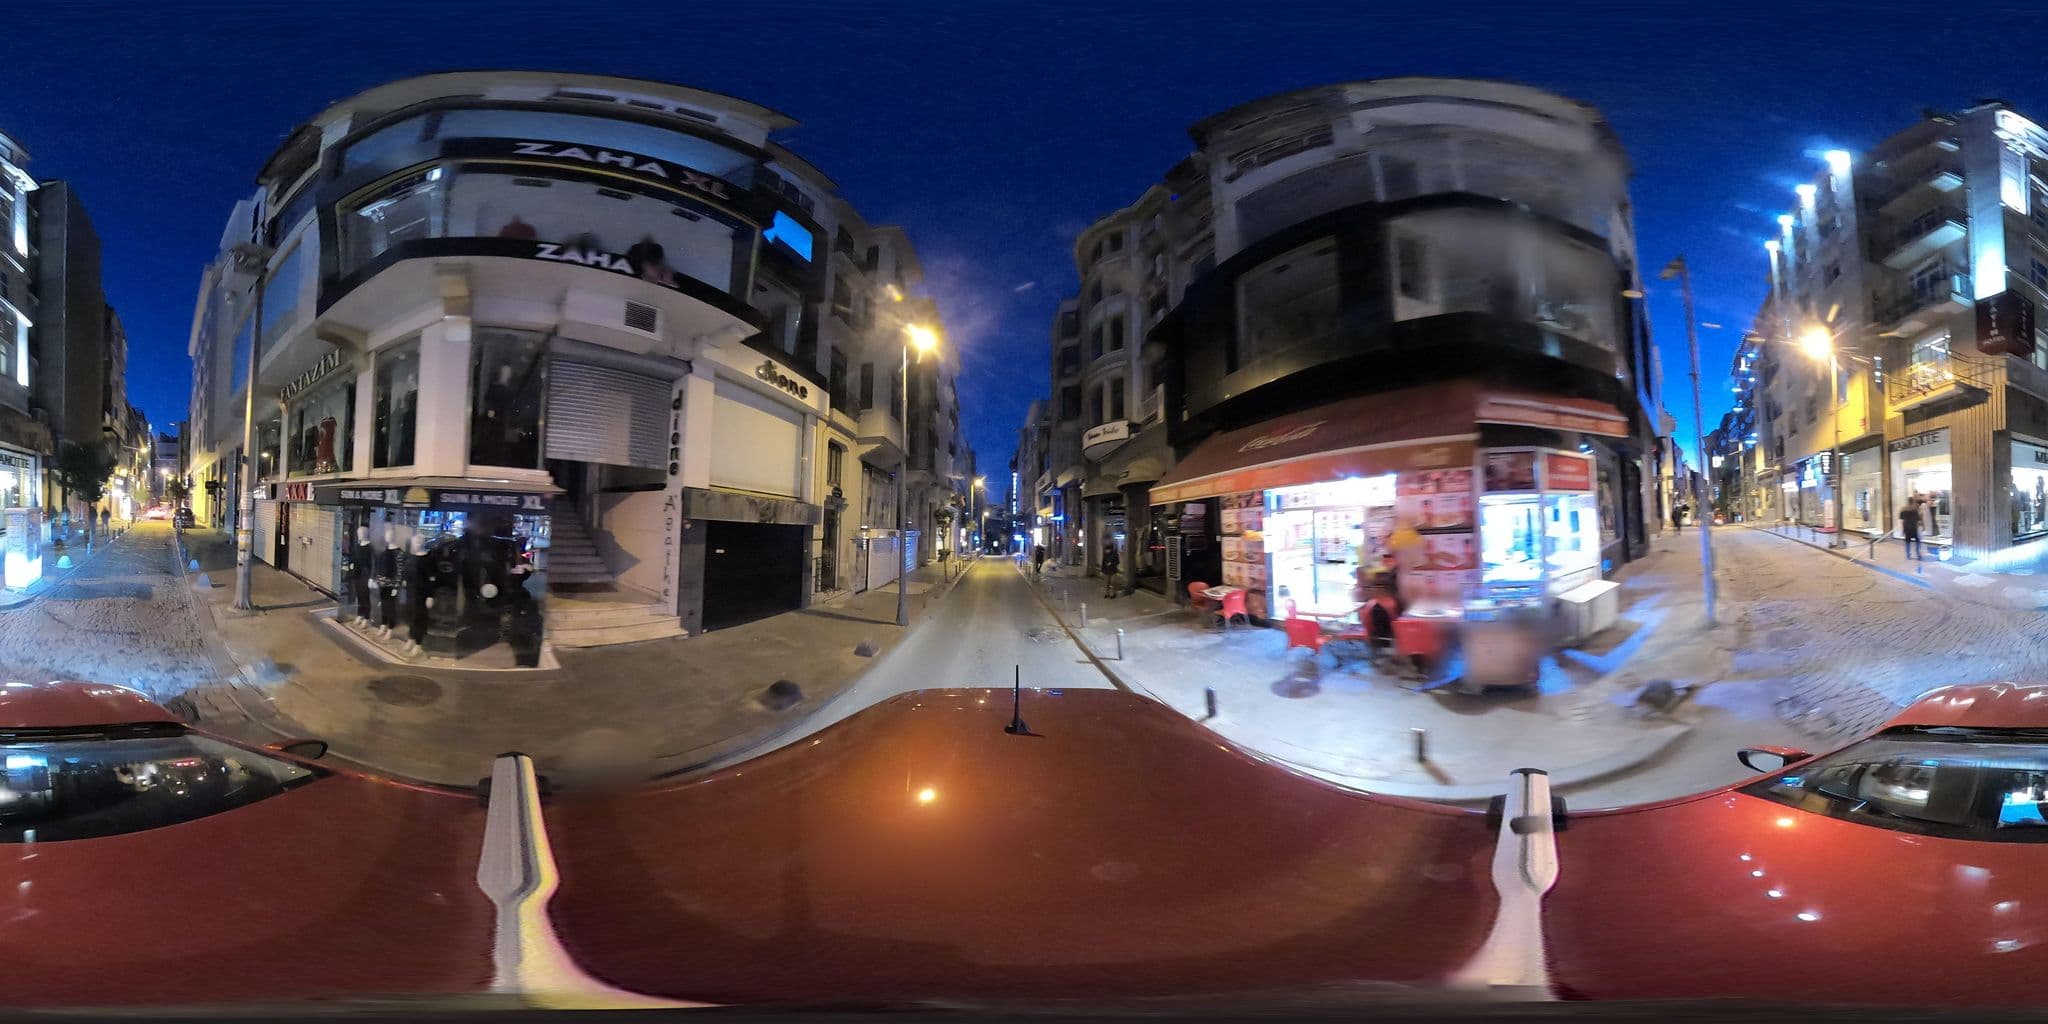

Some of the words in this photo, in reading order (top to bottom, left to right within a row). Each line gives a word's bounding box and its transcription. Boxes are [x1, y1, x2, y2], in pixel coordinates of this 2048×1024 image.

[512, 142, 669, 178] ZAHA
[535, 243, 635, 275] ZAHA
[668, 389, 684, 477] dione
